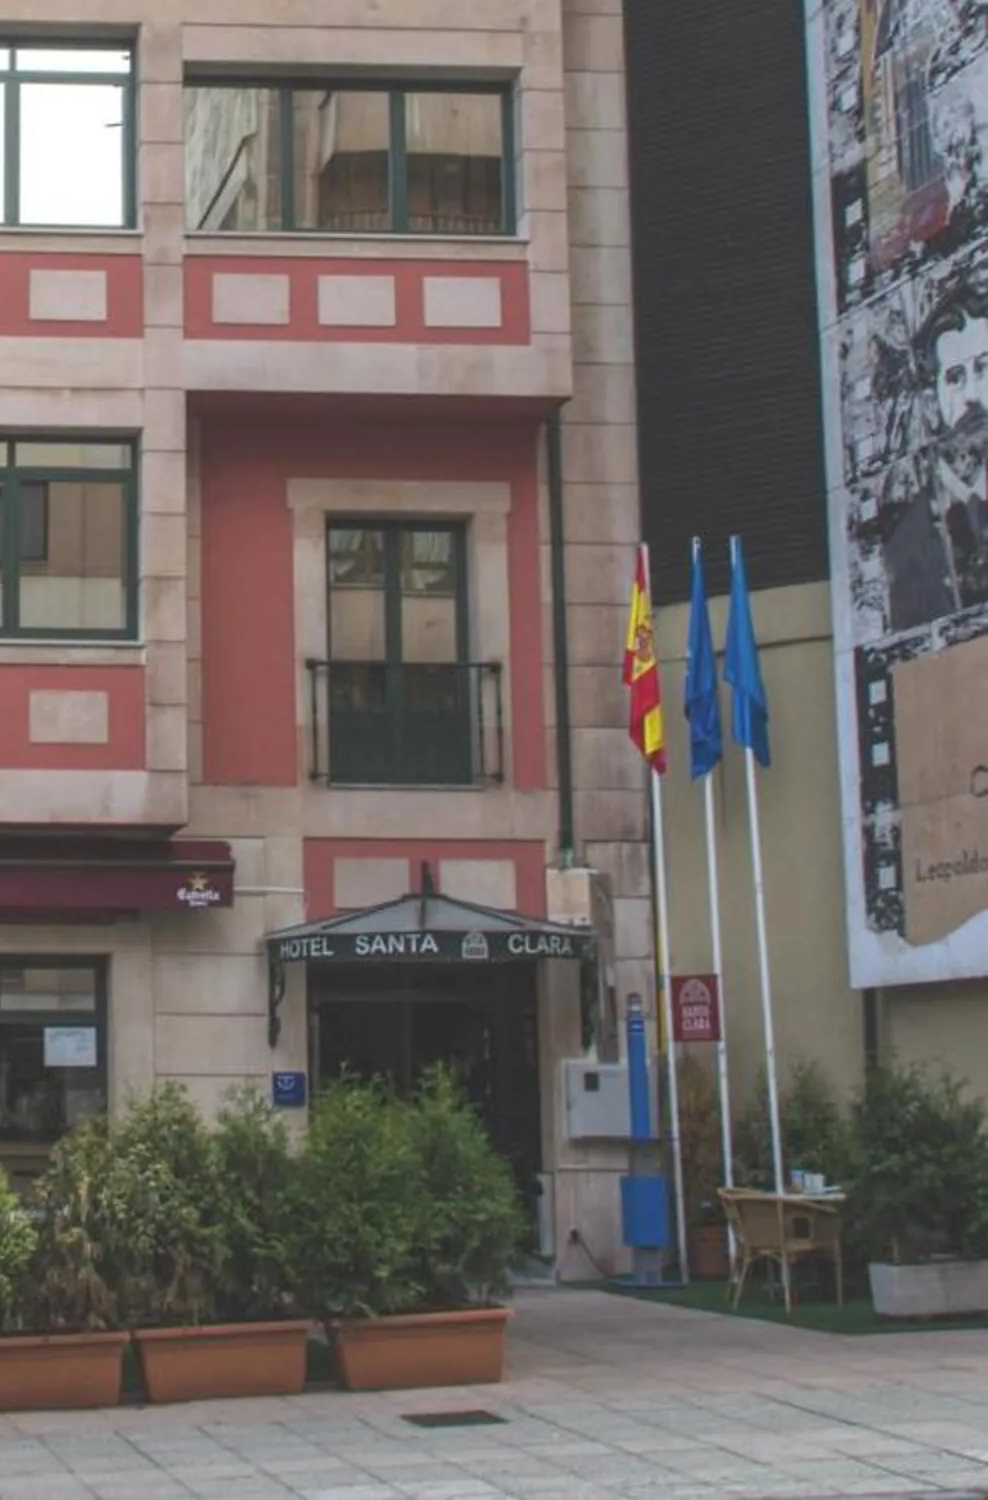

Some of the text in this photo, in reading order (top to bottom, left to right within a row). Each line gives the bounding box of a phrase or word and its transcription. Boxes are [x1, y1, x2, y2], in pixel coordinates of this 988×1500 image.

[280, 933, 574, 958] HOTEL SANTA CLARA
